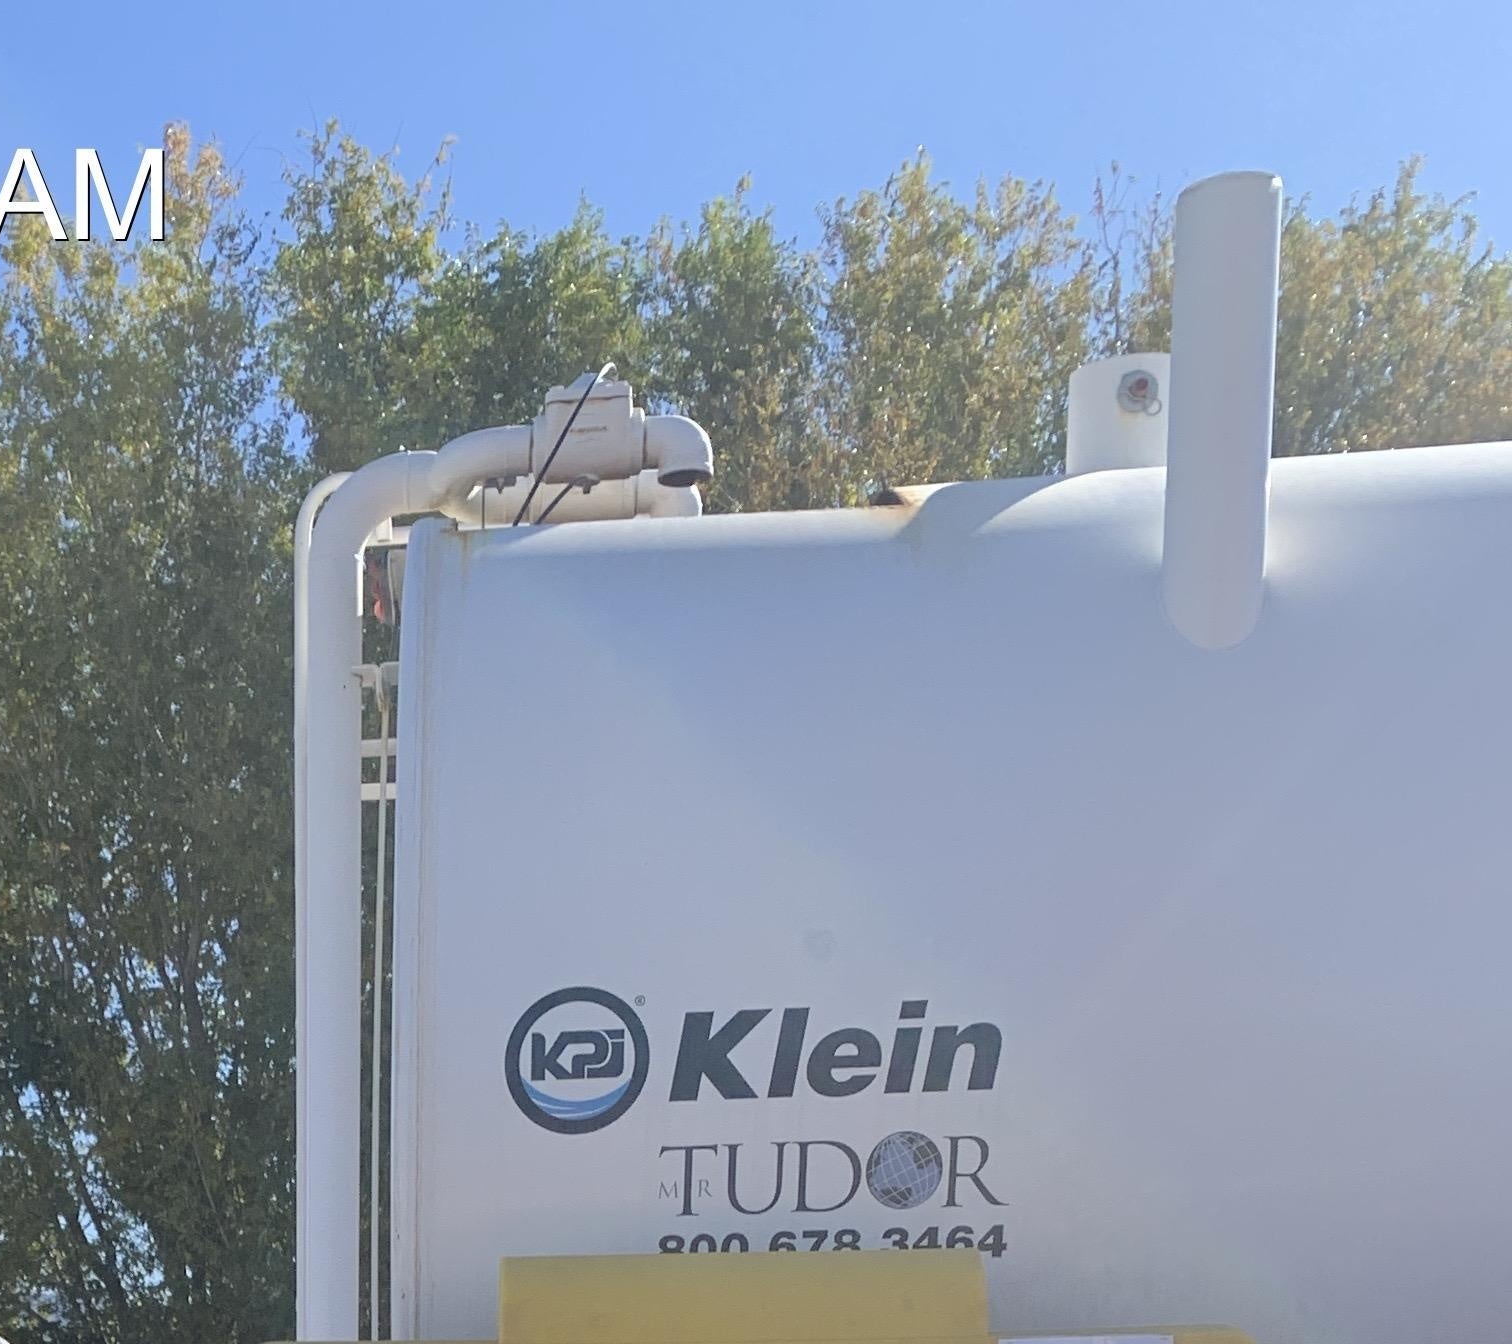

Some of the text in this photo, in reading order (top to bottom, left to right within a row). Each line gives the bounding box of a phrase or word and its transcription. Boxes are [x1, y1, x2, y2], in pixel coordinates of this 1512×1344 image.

[668, 999, 1004, 1102] Klein
[656, 1130, 1010, 1217] TUDOR
[658, 1224, 1008, 1259] 800 678 3464
